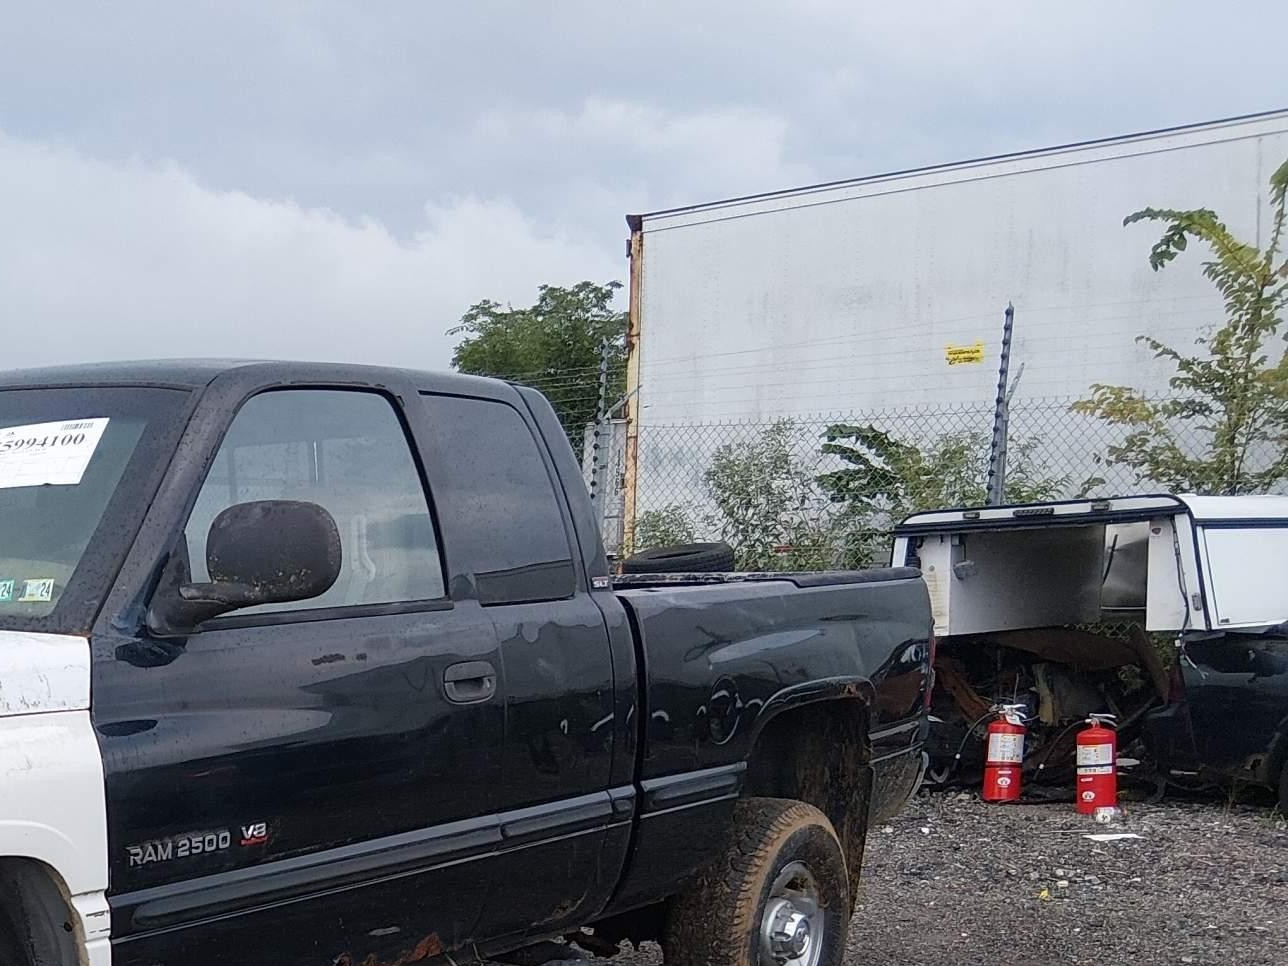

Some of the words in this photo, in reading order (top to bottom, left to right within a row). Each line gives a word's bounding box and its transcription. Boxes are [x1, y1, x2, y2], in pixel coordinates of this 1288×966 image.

[0, 583, 12, 598] 24
[40, 582, 51, 598] 24
[126, 843, 173, 867] RAM
[177, 831, 231, 858] 2500
[240, 822, 268, 840] V8
